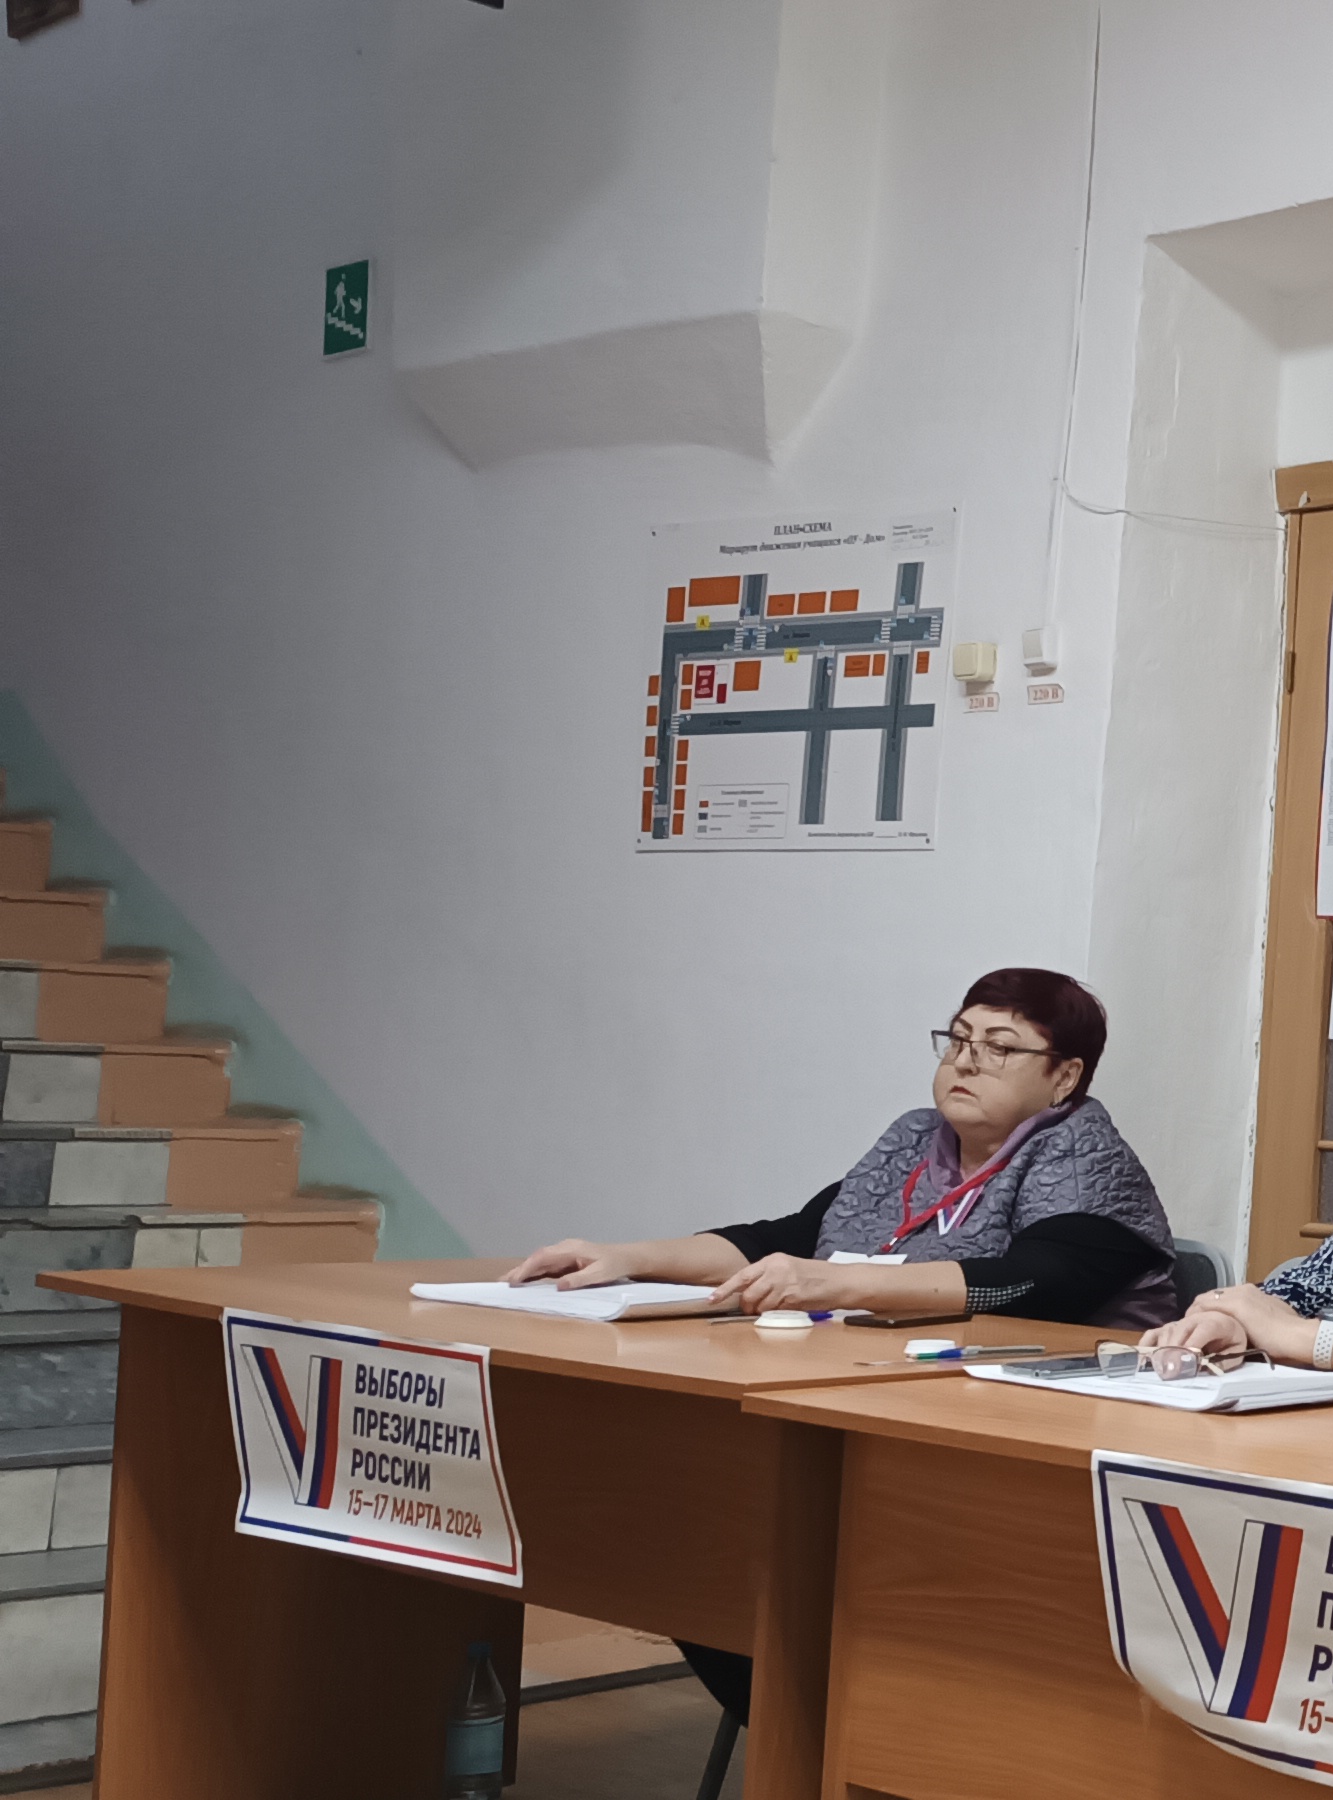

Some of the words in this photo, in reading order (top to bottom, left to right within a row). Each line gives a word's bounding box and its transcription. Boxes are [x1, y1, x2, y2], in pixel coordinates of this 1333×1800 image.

[355, 1363, 446, 1409] ВЫБОРЫ
[352, 1407, 482, 1461] ПРЕЗИДЕНТА
[350, 1448, 432, 1493] РОССИИ
[390, 1500, 443, 1531] МАРТА
[444, 1507, 483, 1539] 2024
